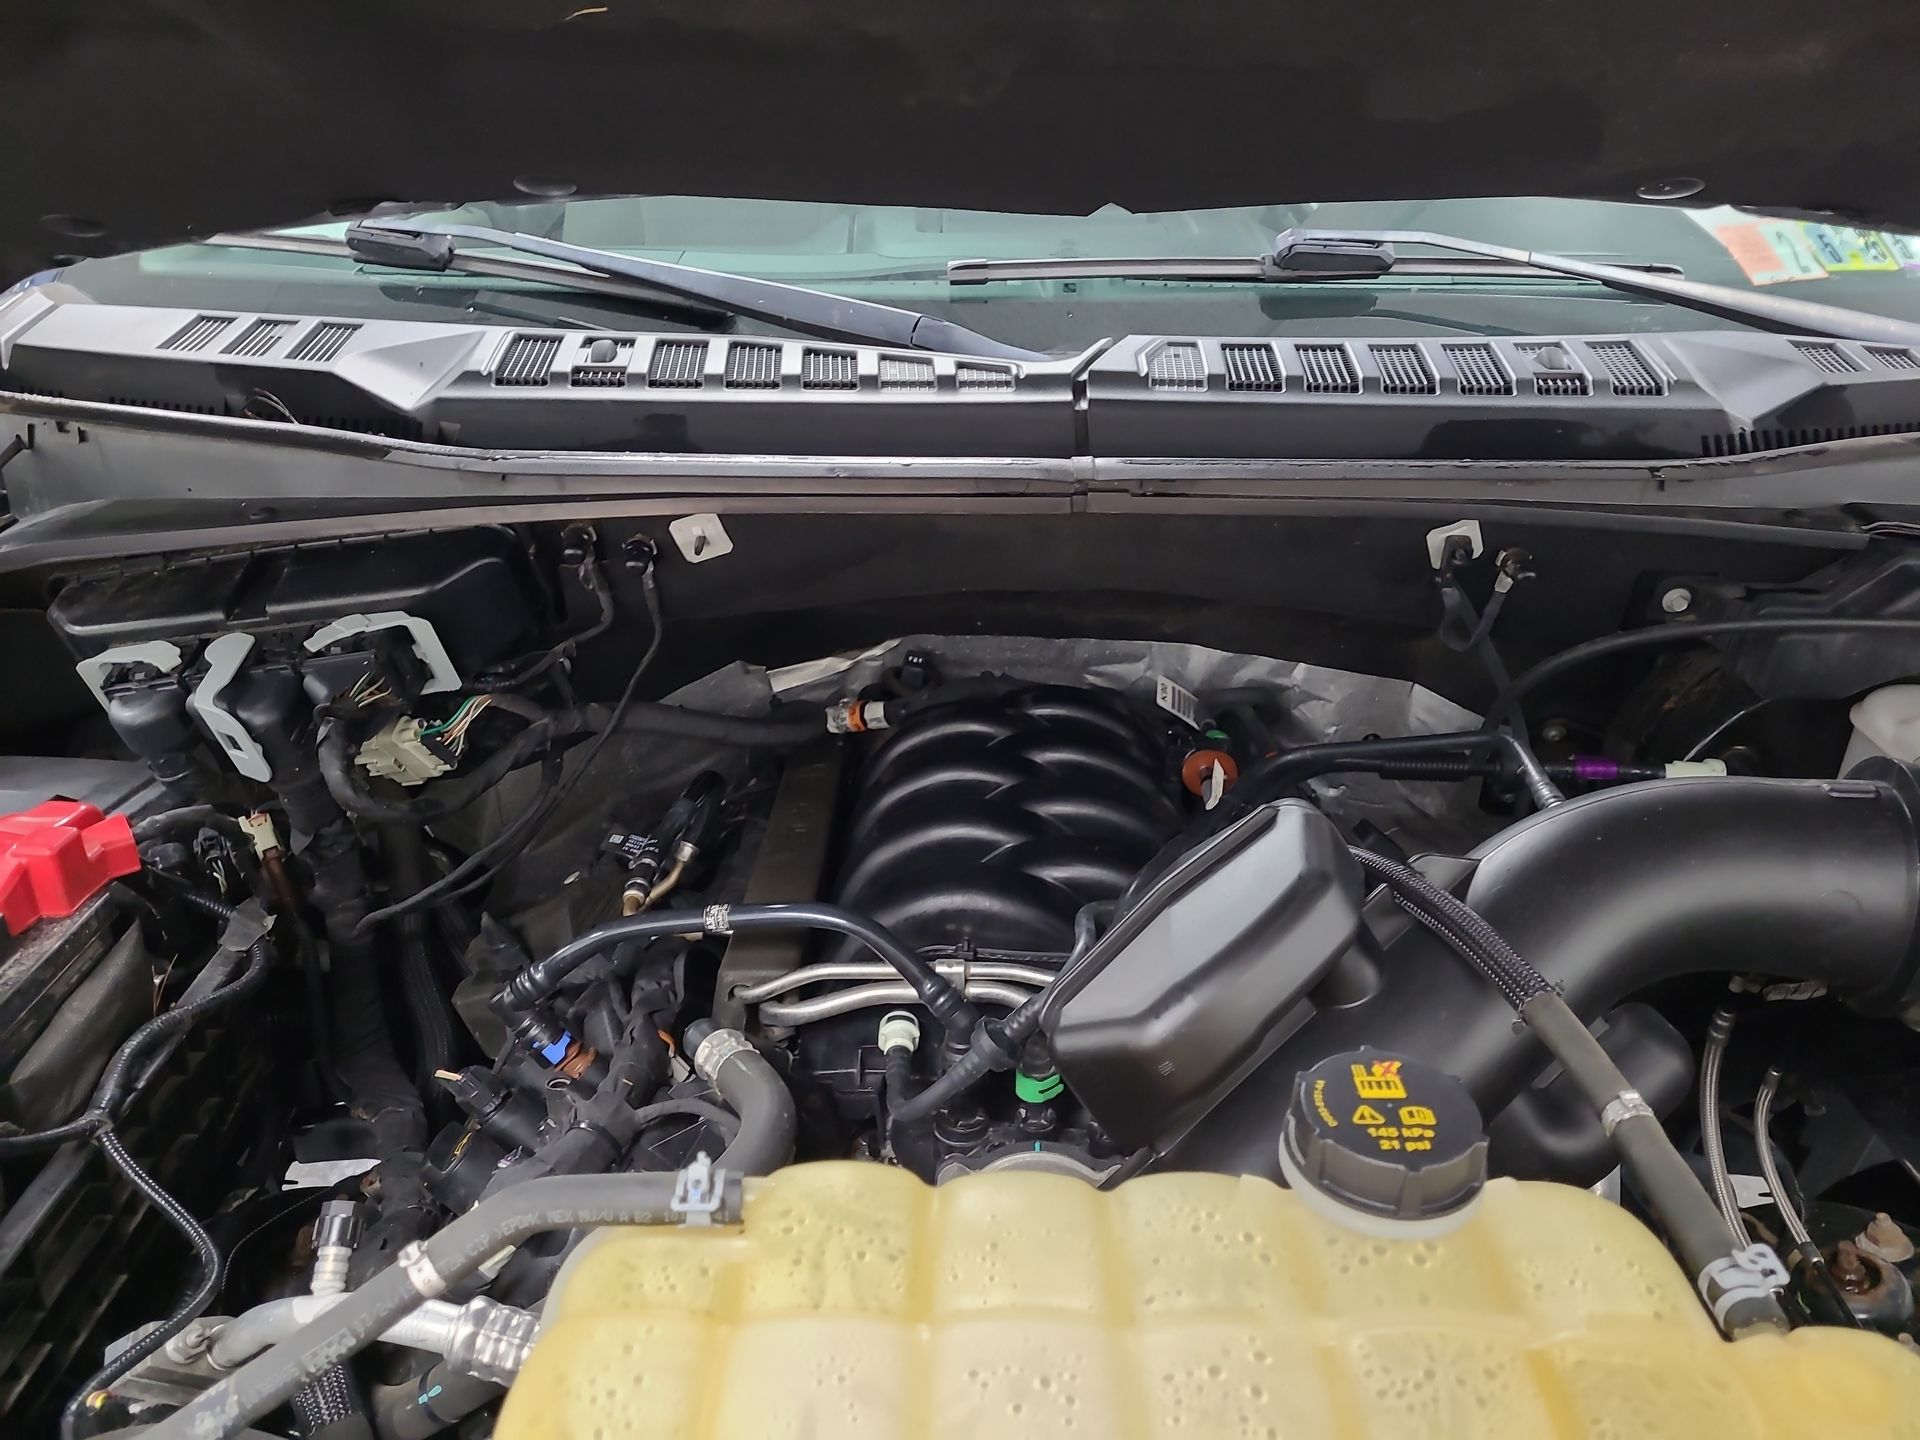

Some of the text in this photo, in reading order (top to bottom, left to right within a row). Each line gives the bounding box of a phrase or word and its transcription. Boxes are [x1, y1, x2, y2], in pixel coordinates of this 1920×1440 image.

[1401, 1127, 1436, 1138] kPa
[1379, 1140, 1432, 1152] 21 psi
